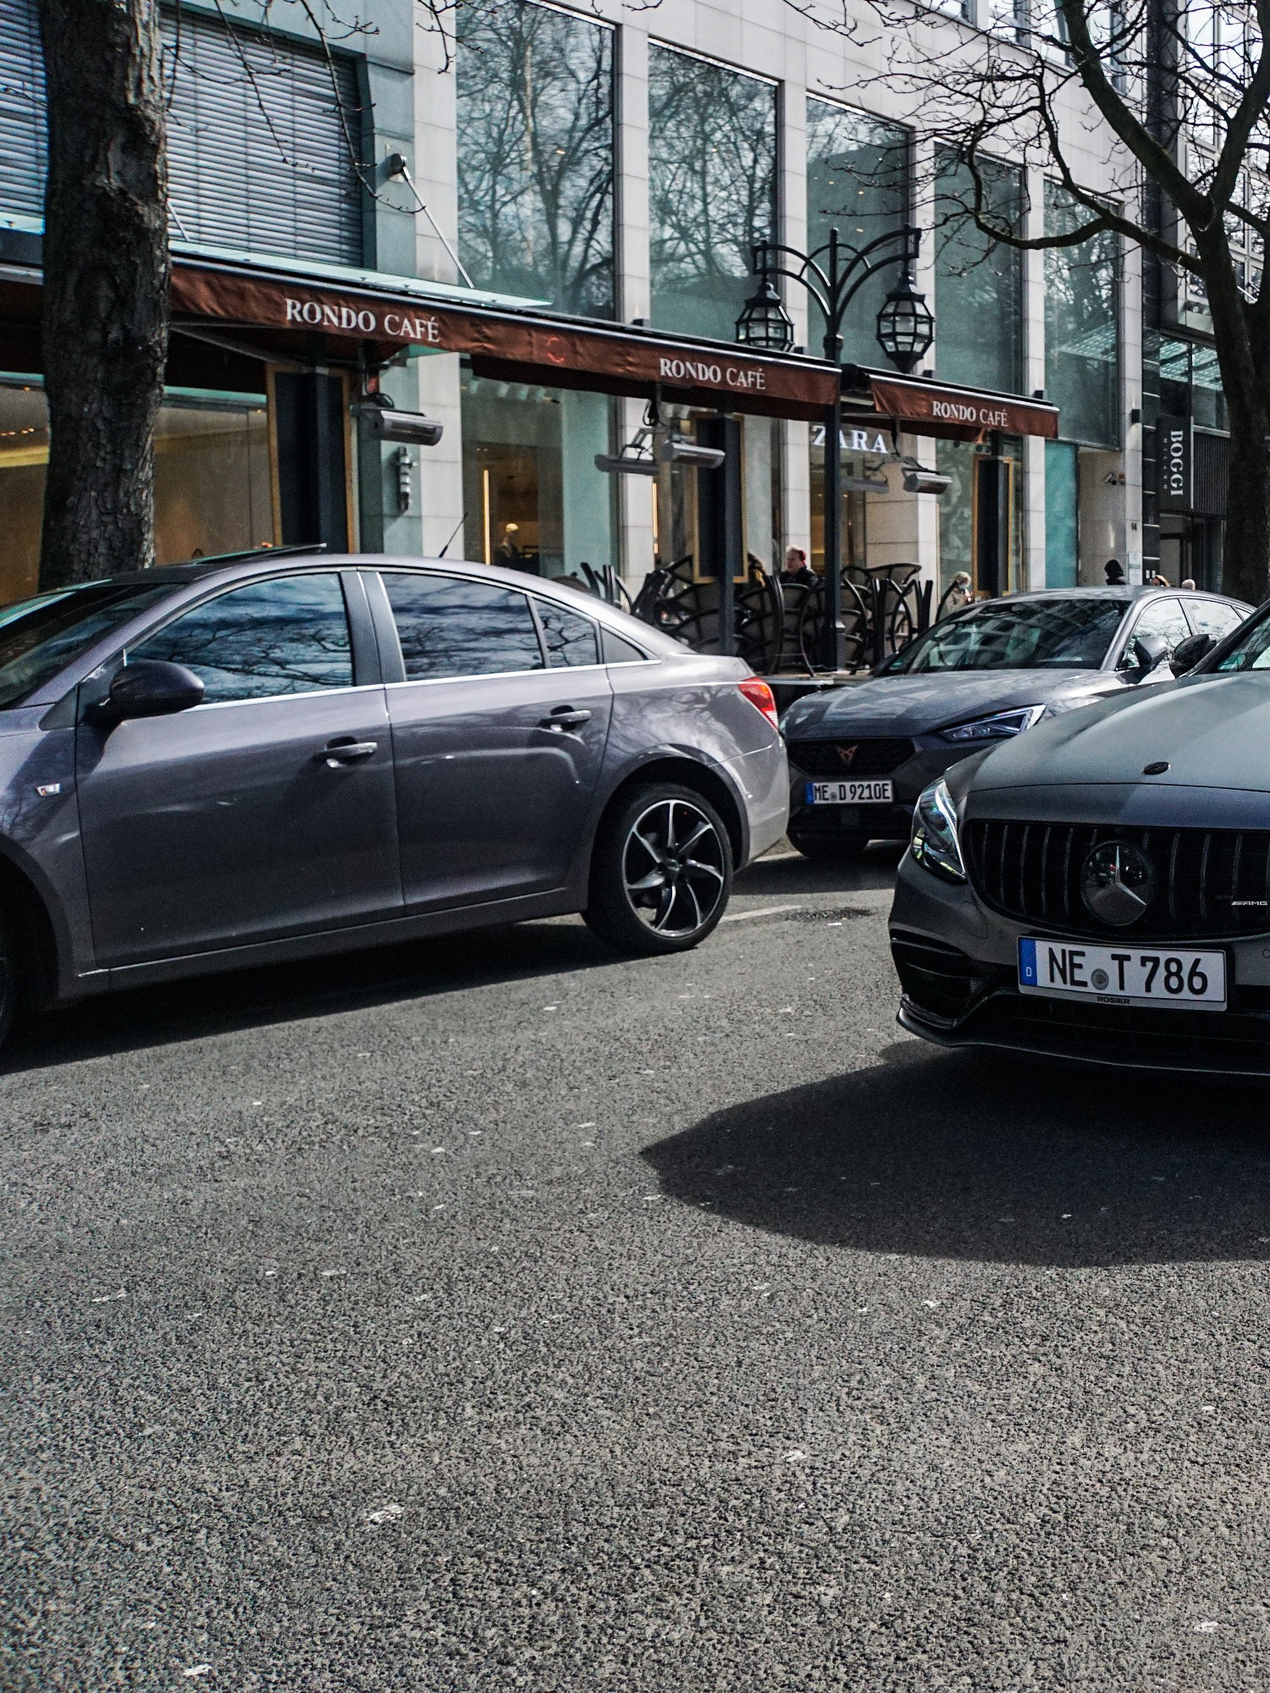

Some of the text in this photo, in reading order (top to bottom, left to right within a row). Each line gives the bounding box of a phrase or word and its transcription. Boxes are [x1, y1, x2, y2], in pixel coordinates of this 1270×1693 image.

[285, 297, 441, 343] RONDO CAFÉ
[659, 358, 766, 390] RONDO CAFÉ
[932, 400, 1009, 427] RONDO CAFÉ
[1169, 429, 1184, 496] BOGGI
[813, 783, 891, 801] ME D 9210E
[1025, 966, 1033, 978] D
[1048, 946, 1209, 996] NE T 786
